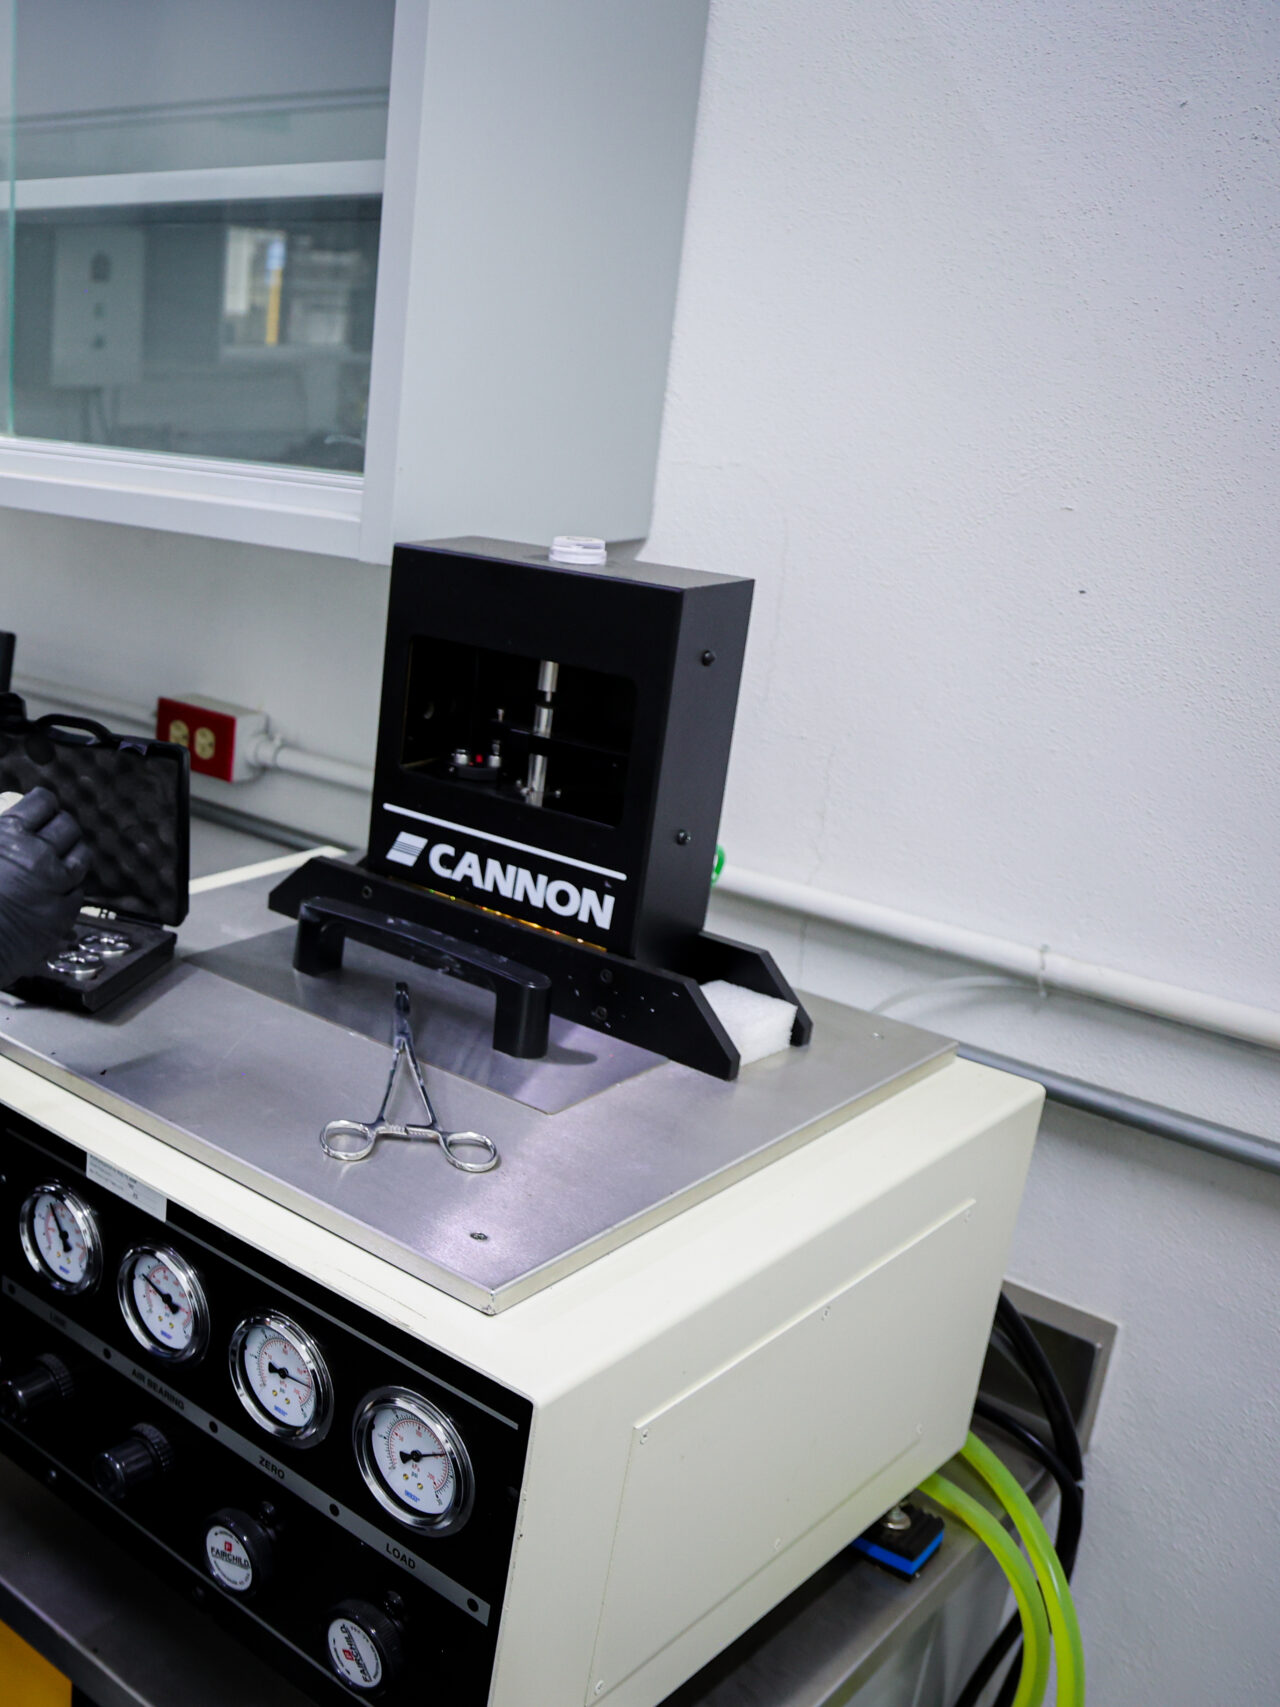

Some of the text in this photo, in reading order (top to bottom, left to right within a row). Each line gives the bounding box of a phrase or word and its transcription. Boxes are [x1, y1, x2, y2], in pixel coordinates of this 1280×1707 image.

[429, 843, 616, 930] CANNON
[132, 1368, 185, 1410] AIR BEARING
[259, 1455, 285, 1480] ZERO
[211, 1547, 250, 1567] FAIRCHILD
[386, 1543, 416, 1570] LOAD
[340, 1624, 371, 1682] FAIRCHILD
